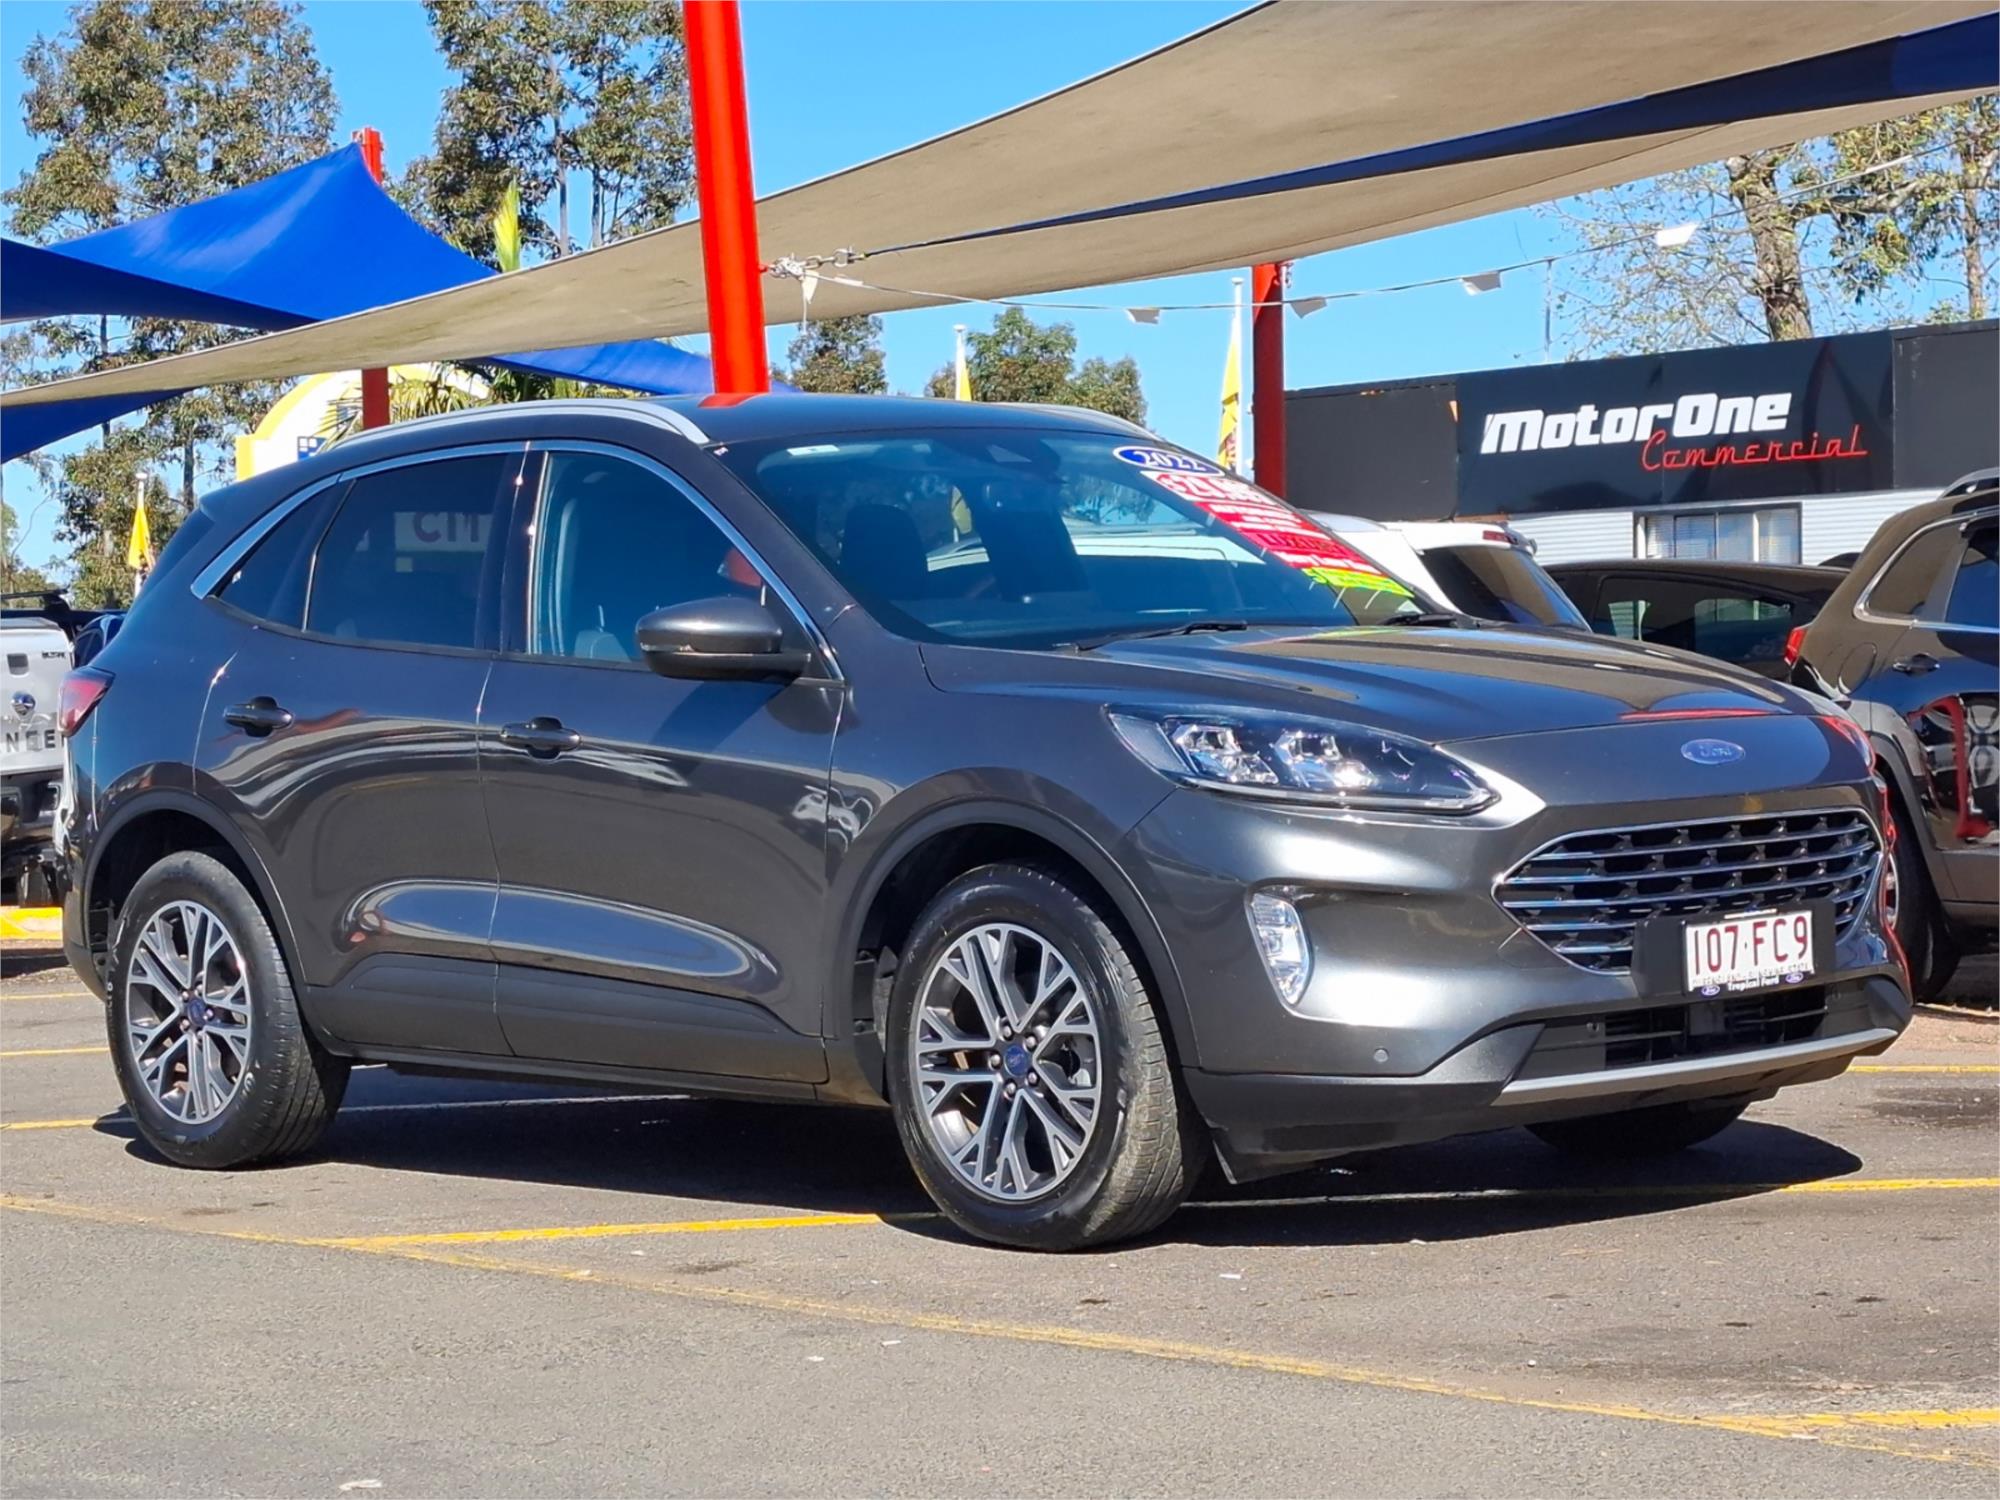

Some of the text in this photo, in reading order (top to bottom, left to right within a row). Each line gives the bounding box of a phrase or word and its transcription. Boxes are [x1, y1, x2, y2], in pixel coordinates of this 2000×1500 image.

[1480, 392, 1793, 455] MotorOne
[1133, 449, 1207, 472] 2022
[1641, 424, 1868, 472] Commercial
